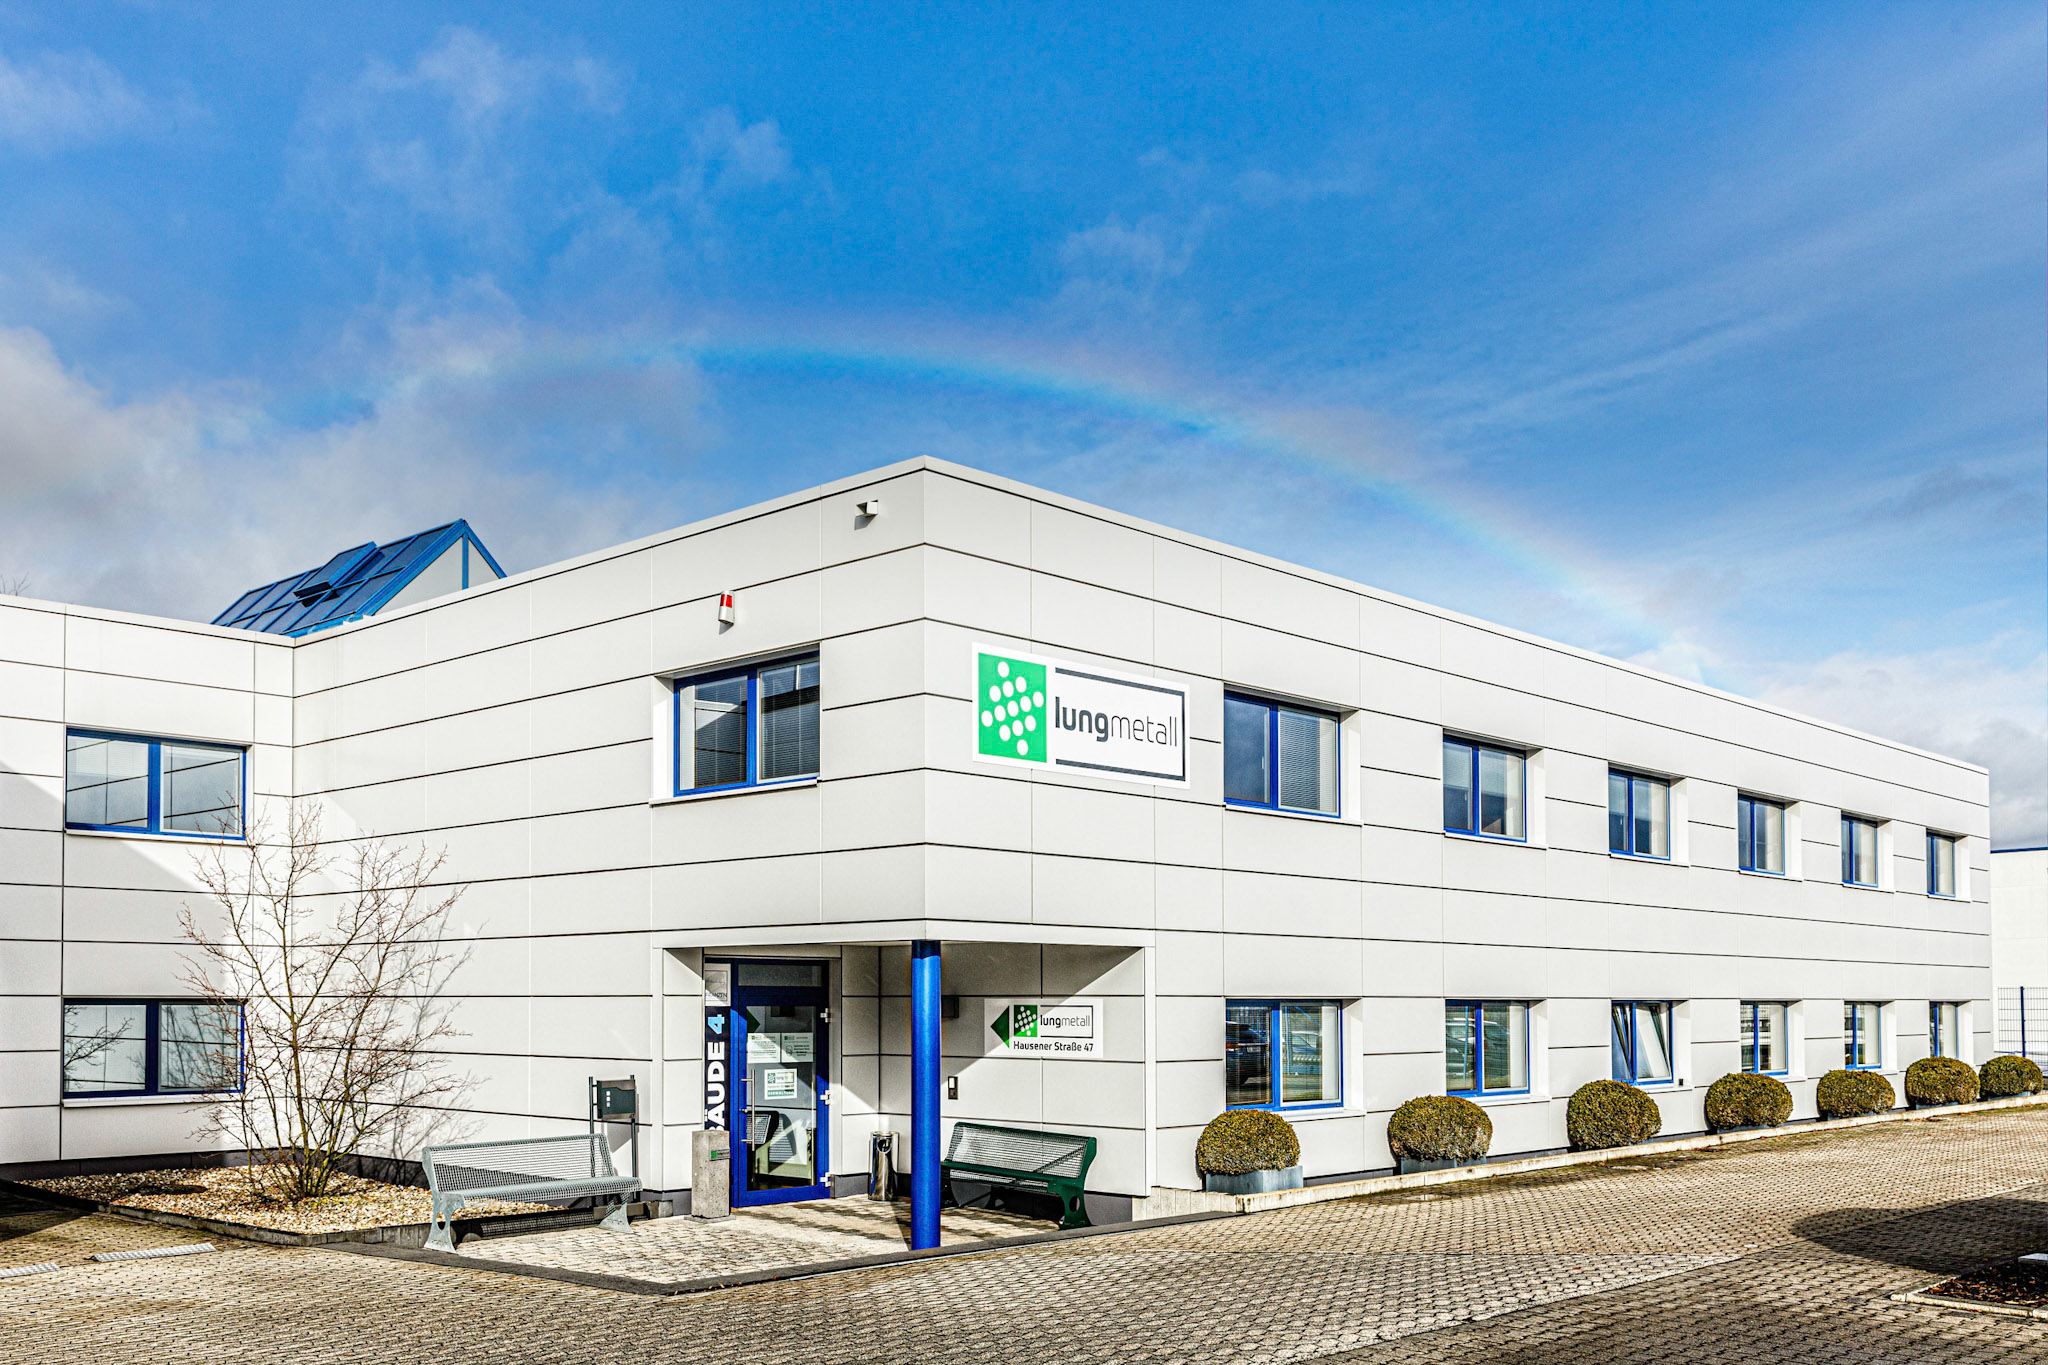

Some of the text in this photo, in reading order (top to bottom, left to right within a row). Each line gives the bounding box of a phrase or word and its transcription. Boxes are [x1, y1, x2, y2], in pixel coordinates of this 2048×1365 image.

[1055, 696, 1177, 747] lungmetall
[707, 1014, 725, 1035] 4
[1040, 1014, 1091, 1028] lungmetall
[1013, 1041, 1094, 1052] Hausener Straße 47
[704, 1041, 725, 1130] ÄUDE
